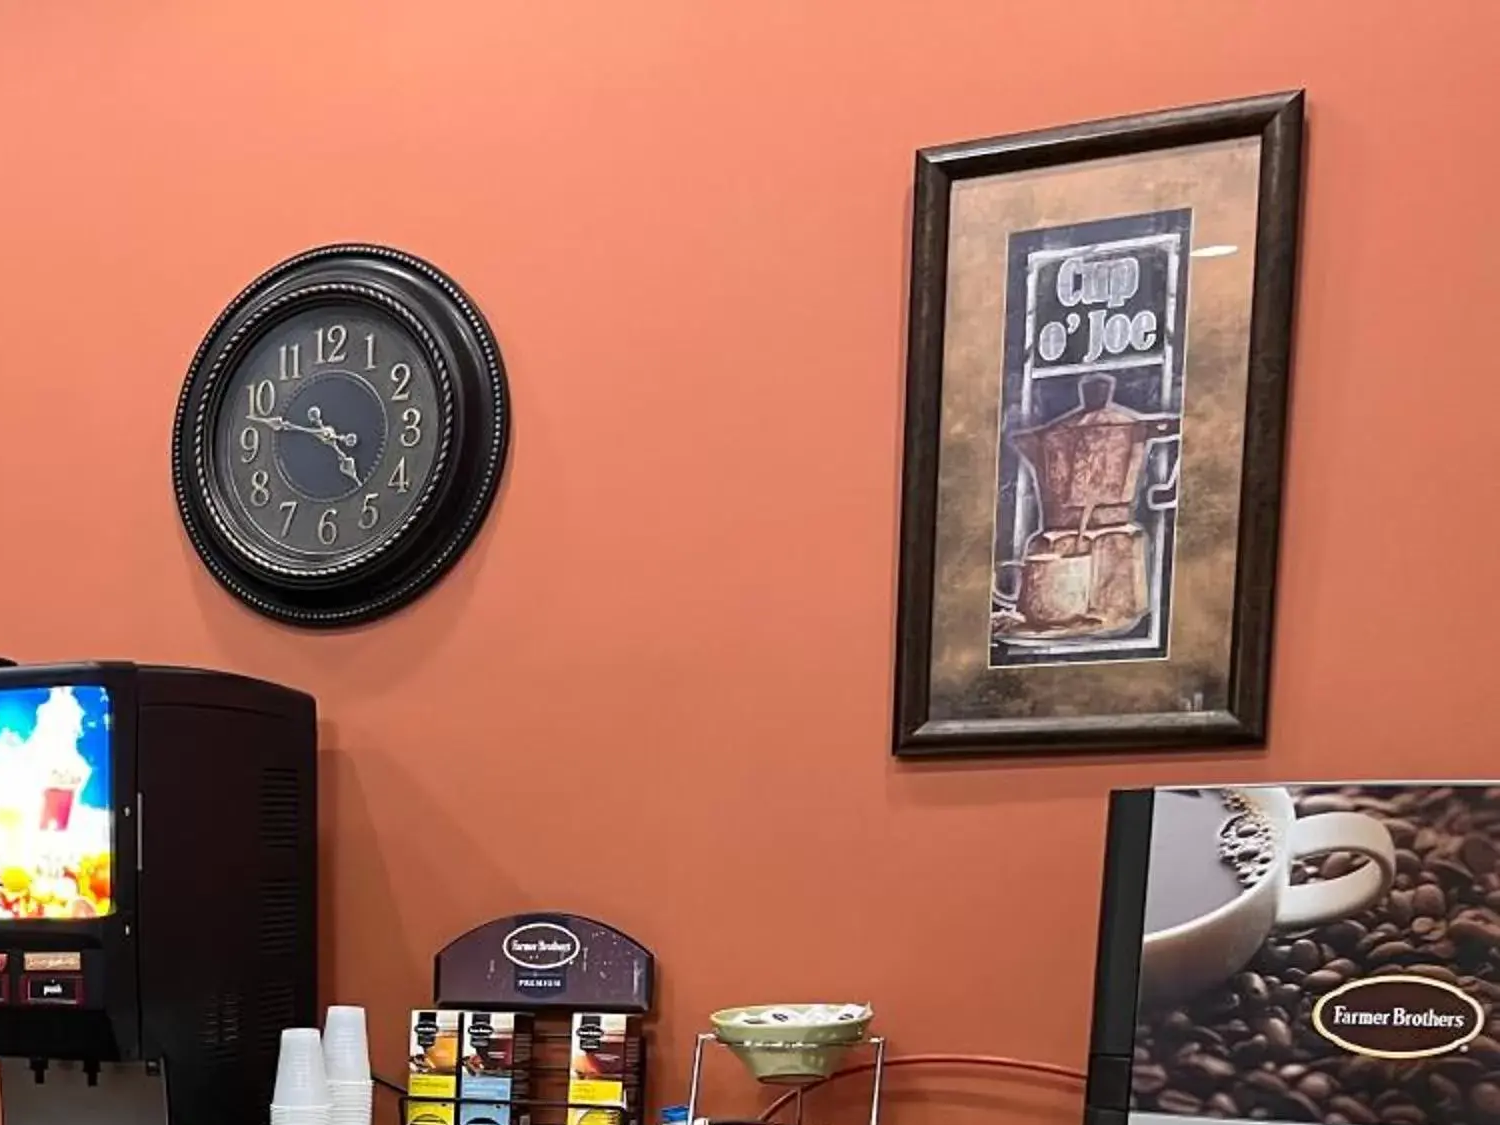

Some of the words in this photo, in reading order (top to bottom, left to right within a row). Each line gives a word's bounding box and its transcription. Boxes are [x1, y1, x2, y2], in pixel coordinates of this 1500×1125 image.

[1057, 257, 1139, 308] Cup
[314, 324, 348, 364] 12
[364, 333, 377, 370] 1
[1083, 309, 1157, 362] Joe
[278, 343, 301, 380] 11
[246, 379, 276, 417] 10
[390, 363, 411, 401] 2
[240, 426, 260, 464] 9
[400, 407, 421, 447] 3
[251, 469, 269, 507] 8
[388, 456, 410, 493] 4
[279, 500, 299, 538] 7
[317, 507, 338, 545] 6
[358, 492, 380, 529] 5
[1333, 1005, 1392, 1026] Farmer
[1393, 1007, 1465, 1028] Brothers
